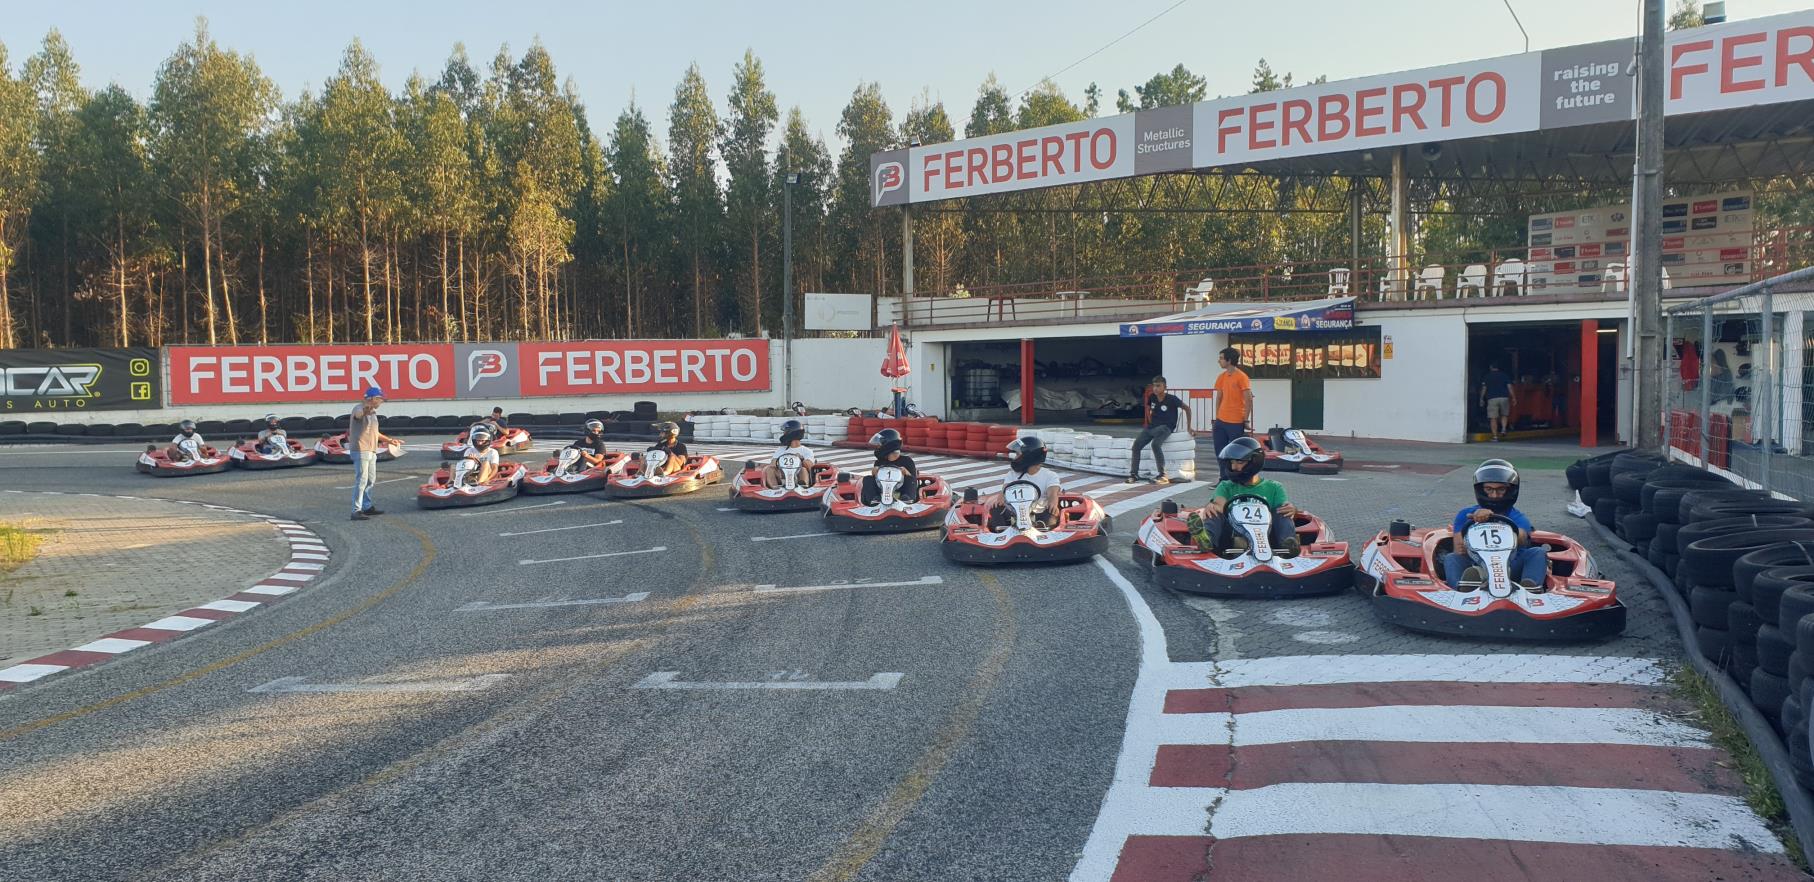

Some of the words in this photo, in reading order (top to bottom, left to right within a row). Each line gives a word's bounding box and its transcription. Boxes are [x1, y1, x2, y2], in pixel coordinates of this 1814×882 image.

[1554, 62, 1619, 81] raising
[1570, 79, 1601, 93] the
[1555, 92, 1615, 110] future
[1217, 71, 1507, 154] FERBERTO
[1143, 127, 1184, 142] Metallic
[1136, 138, 1191, 154] Structures
[923, 127, 1117, 193] FERBERTO
[1187, 320, 1243, 332] SEGURANÇA
[1315, 319, 1353, 330] SEGURANÇA
[189, 353, 439, 393] FERBERTO
[538, 348, 757, 386] FERBERTO
[34, 399, 86, 408] AUTO
[783, 457, 794, 466] 29
[887, 470, 892, 478] 1
[1012, 489, 1024, 499] 11
[1242, 507, 1263, 520] 24
[1480, 529, 1502, 545] 15
